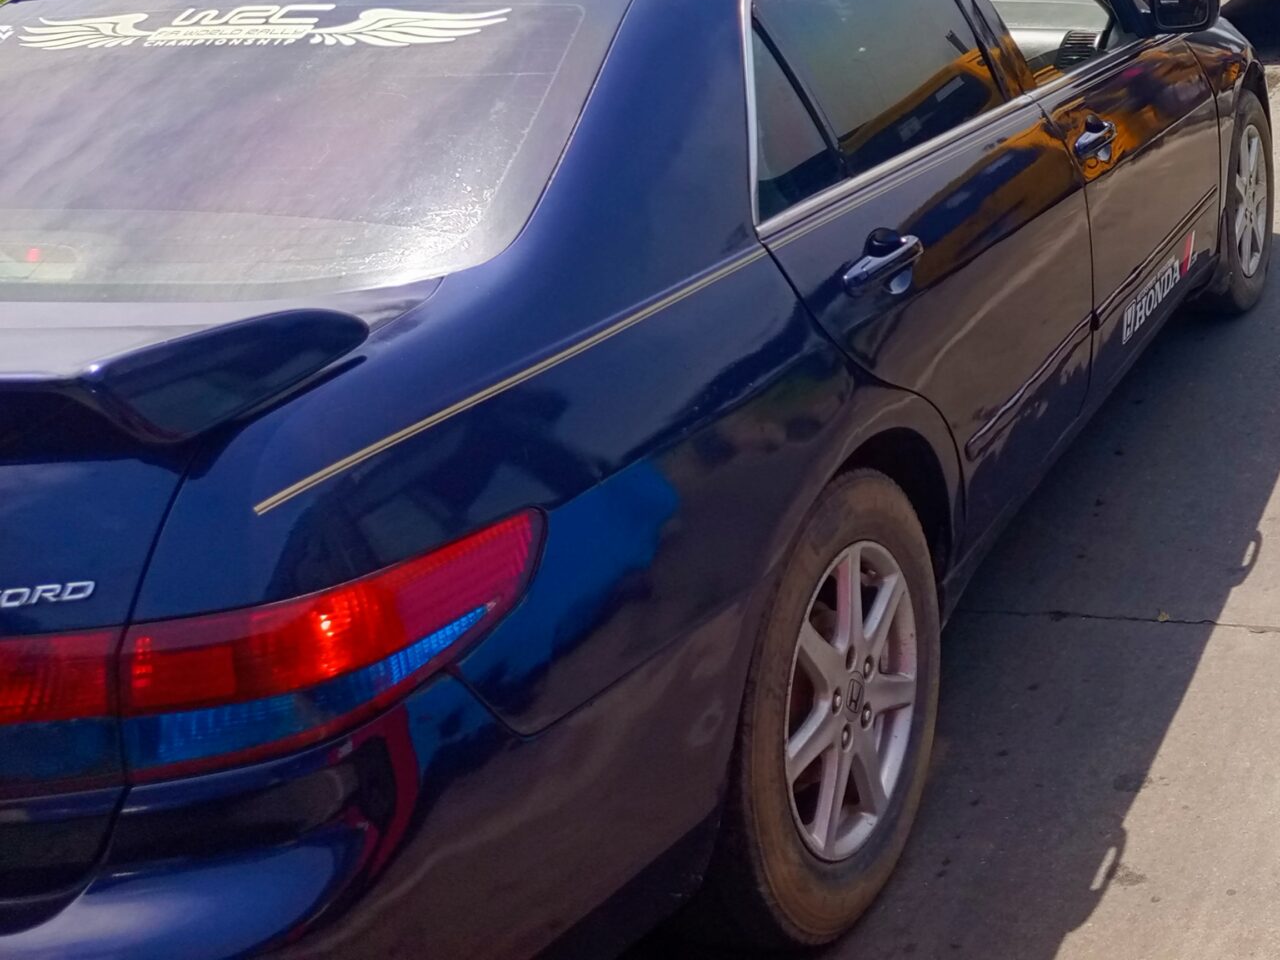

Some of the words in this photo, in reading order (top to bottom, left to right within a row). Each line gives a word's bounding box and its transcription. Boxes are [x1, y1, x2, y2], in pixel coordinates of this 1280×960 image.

[171, 4, 336, 26] WRC
[143, 38, 297, 48] CHAMPIONSHIP
[183, 28, 243, 36] WORLD
[245, 28, 306, 36] RALLY
[1134, 258, 1181, 333] HONDA
[0, 581, 95, 609] ORD
